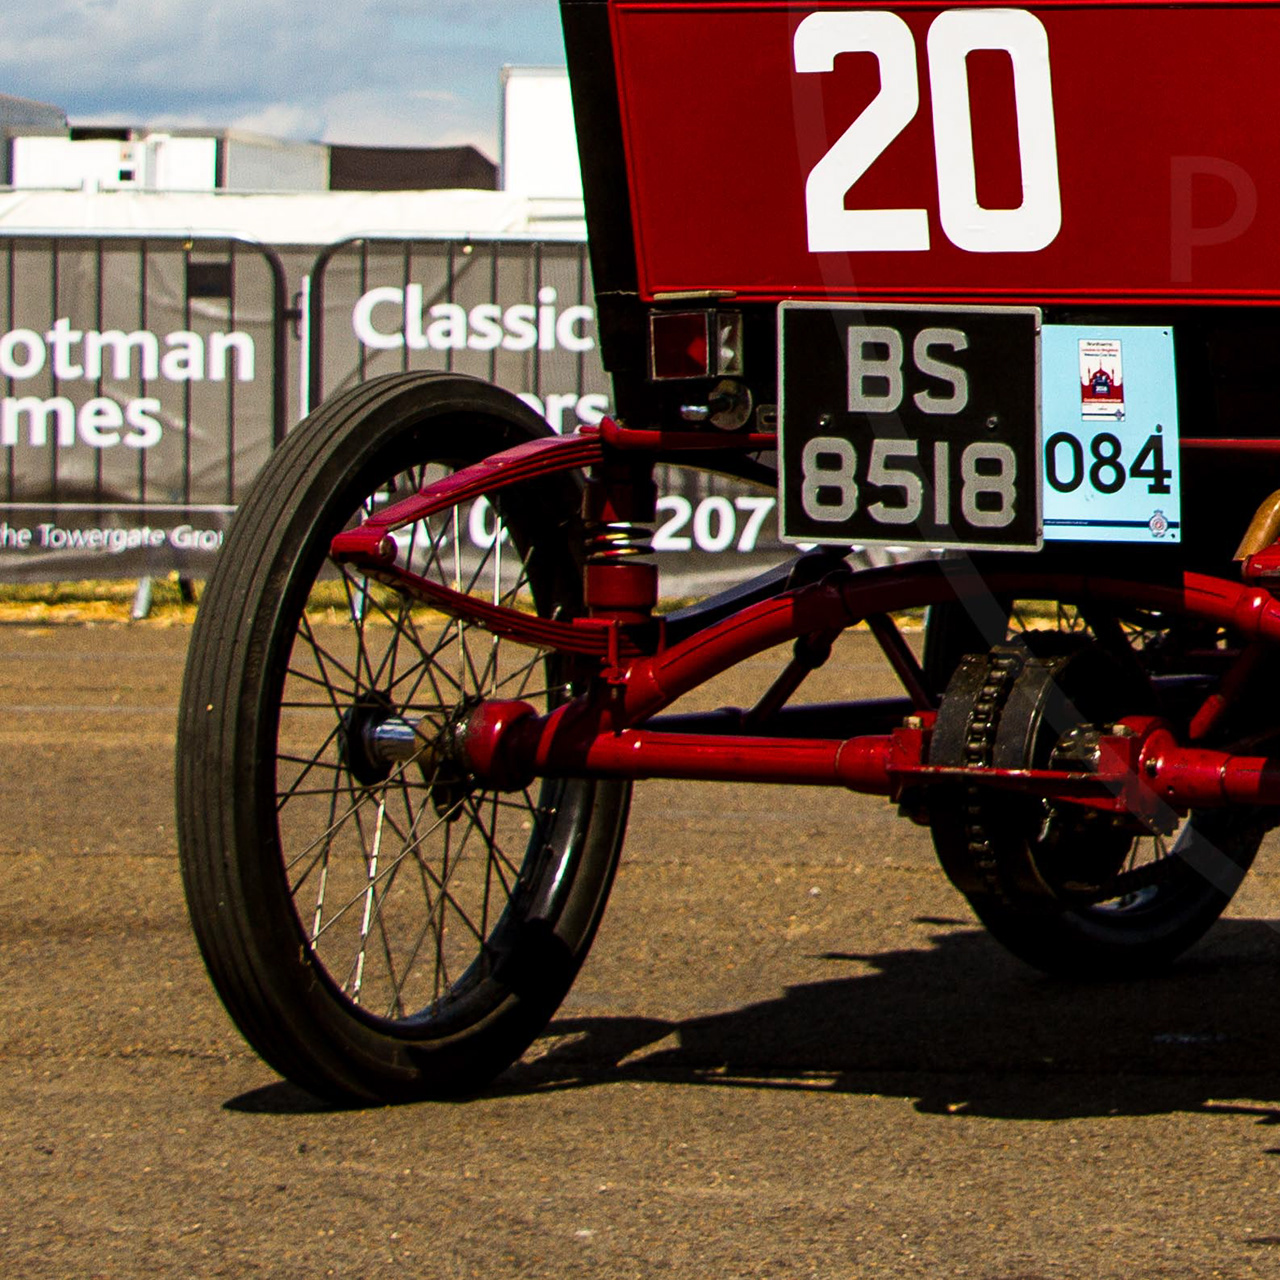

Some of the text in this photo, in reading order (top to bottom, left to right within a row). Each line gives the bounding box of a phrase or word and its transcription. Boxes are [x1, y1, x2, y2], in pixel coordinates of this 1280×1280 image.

[793, 8, 1062, 253] 20
[352, 283, 596, 351] Classic
[847, 325, 969, 415] BS
[801, 437, 1018, 527] 8518
[1044, 431, 1172, 496] 084
[37, 523, 166, 554] Towergate
[651, 495, 777, 553] 207
